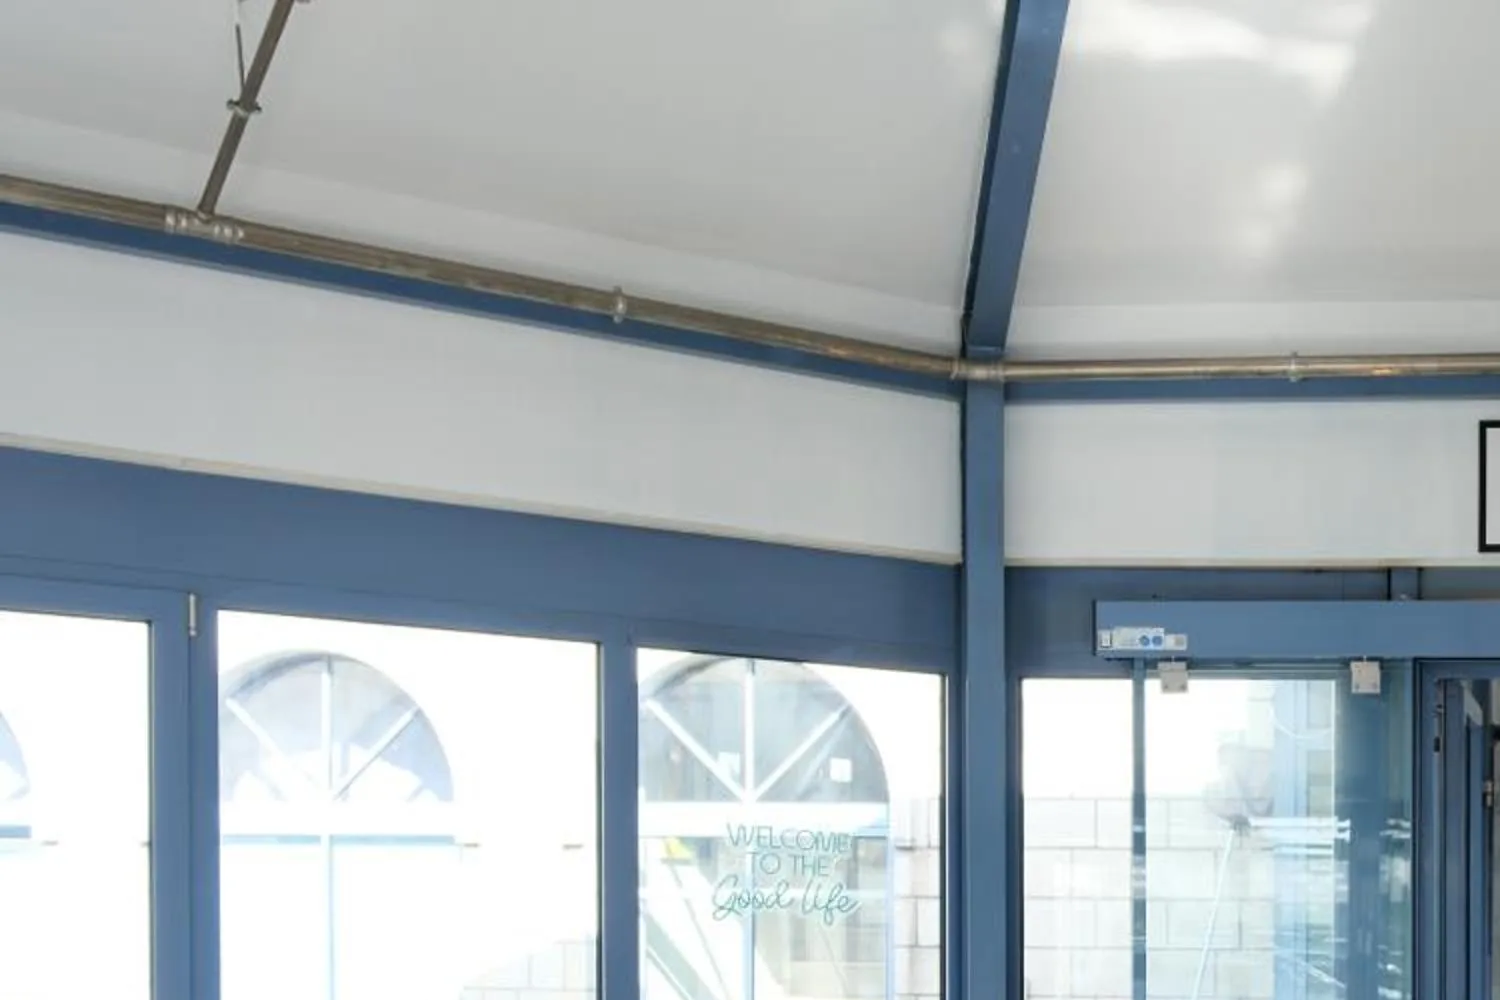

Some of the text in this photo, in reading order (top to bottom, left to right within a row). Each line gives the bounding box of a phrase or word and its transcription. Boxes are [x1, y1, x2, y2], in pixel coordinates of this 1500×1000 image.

[726, 823, 852, 852] WELCOME
[748, 851, 831, 877] TO THE
[712, 874, 863, 926] Good life
